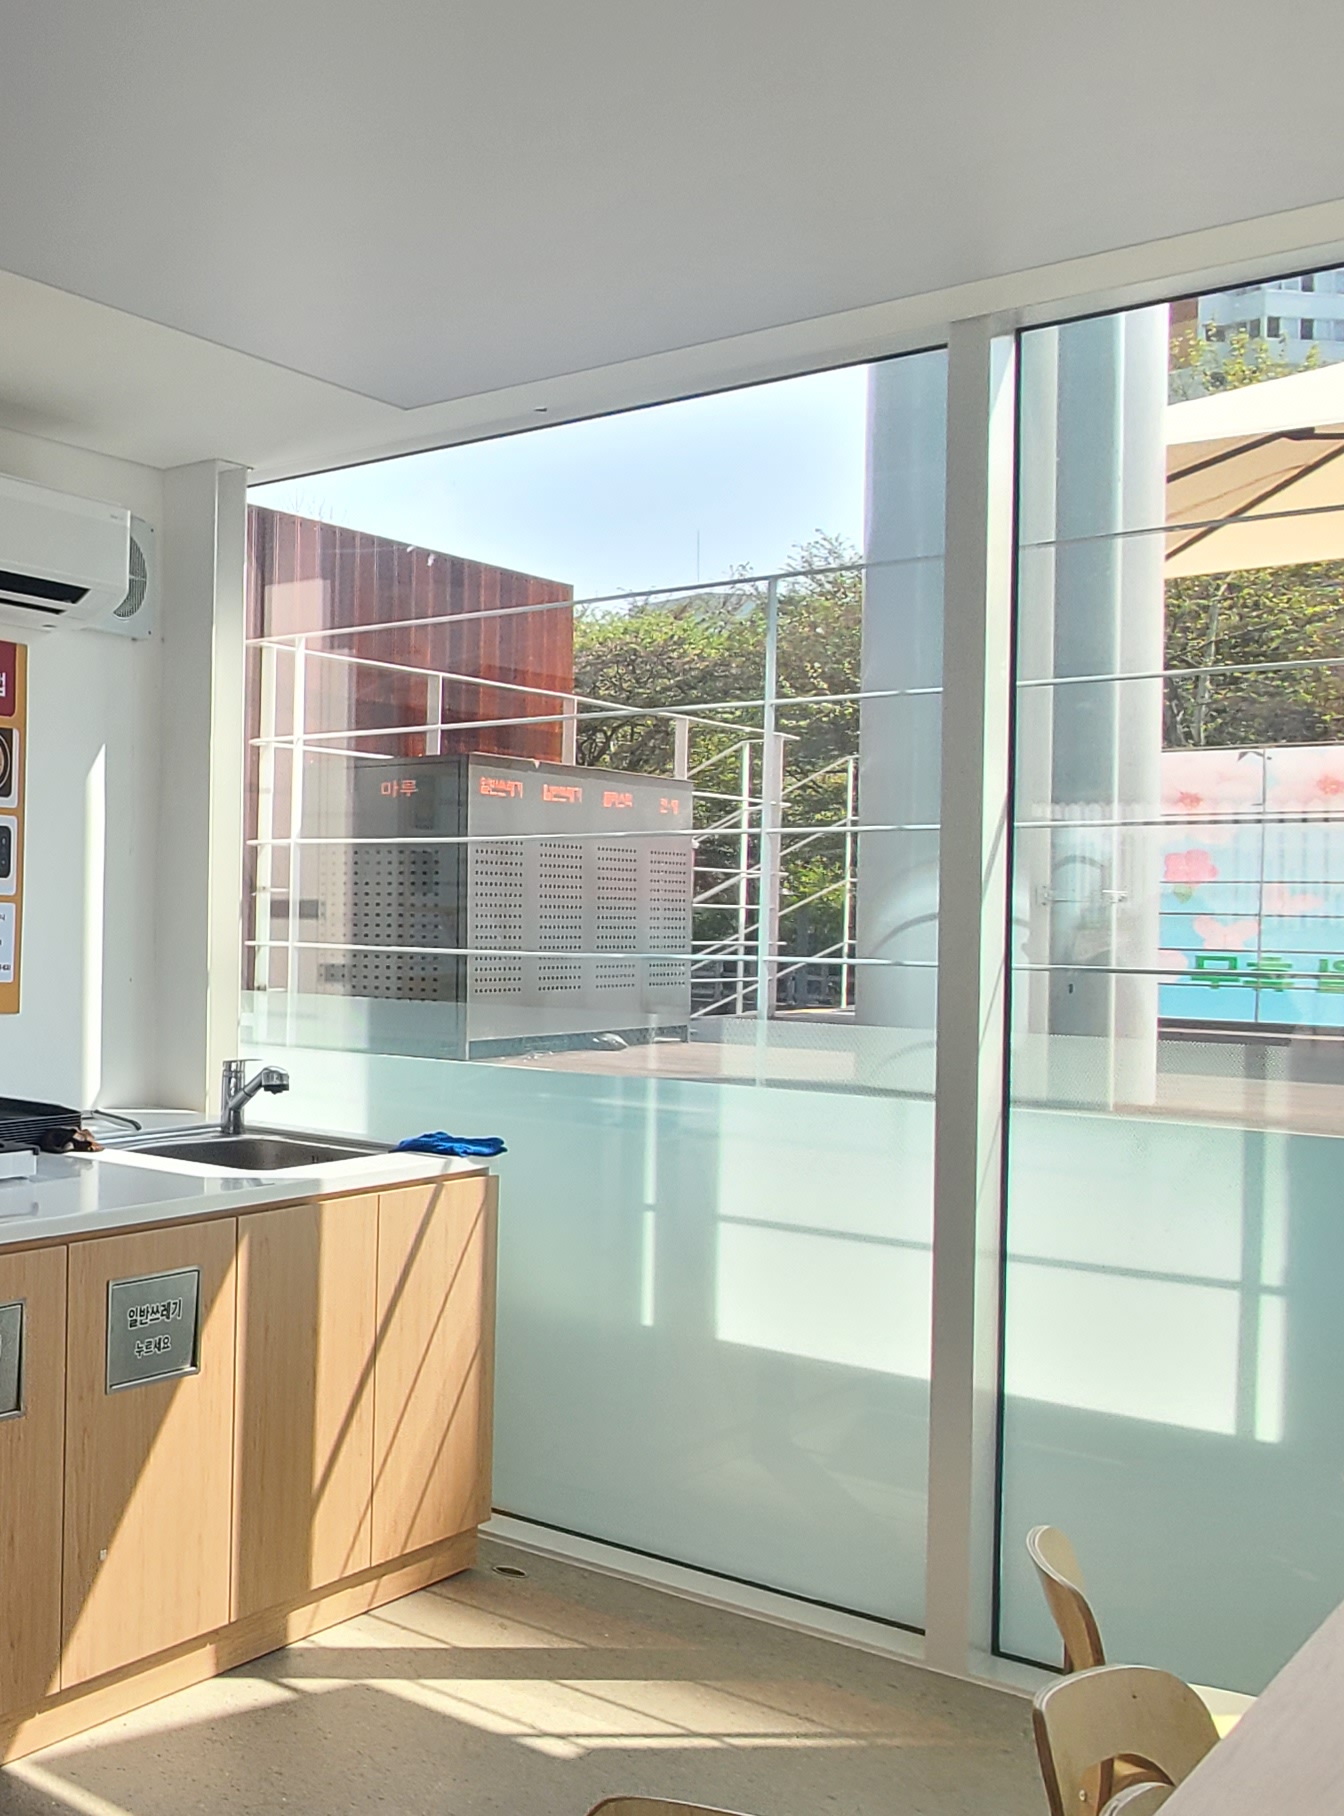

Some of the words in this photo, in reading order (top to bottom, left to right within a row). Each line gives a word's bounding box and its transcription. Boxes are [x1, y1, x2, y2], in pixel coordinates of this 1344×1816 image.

[381, 779, 418, 798] 마루
[127, 1298, 183, 1329] 일반쓰레기
[135, 1336, 171, 1357] 누르세요
